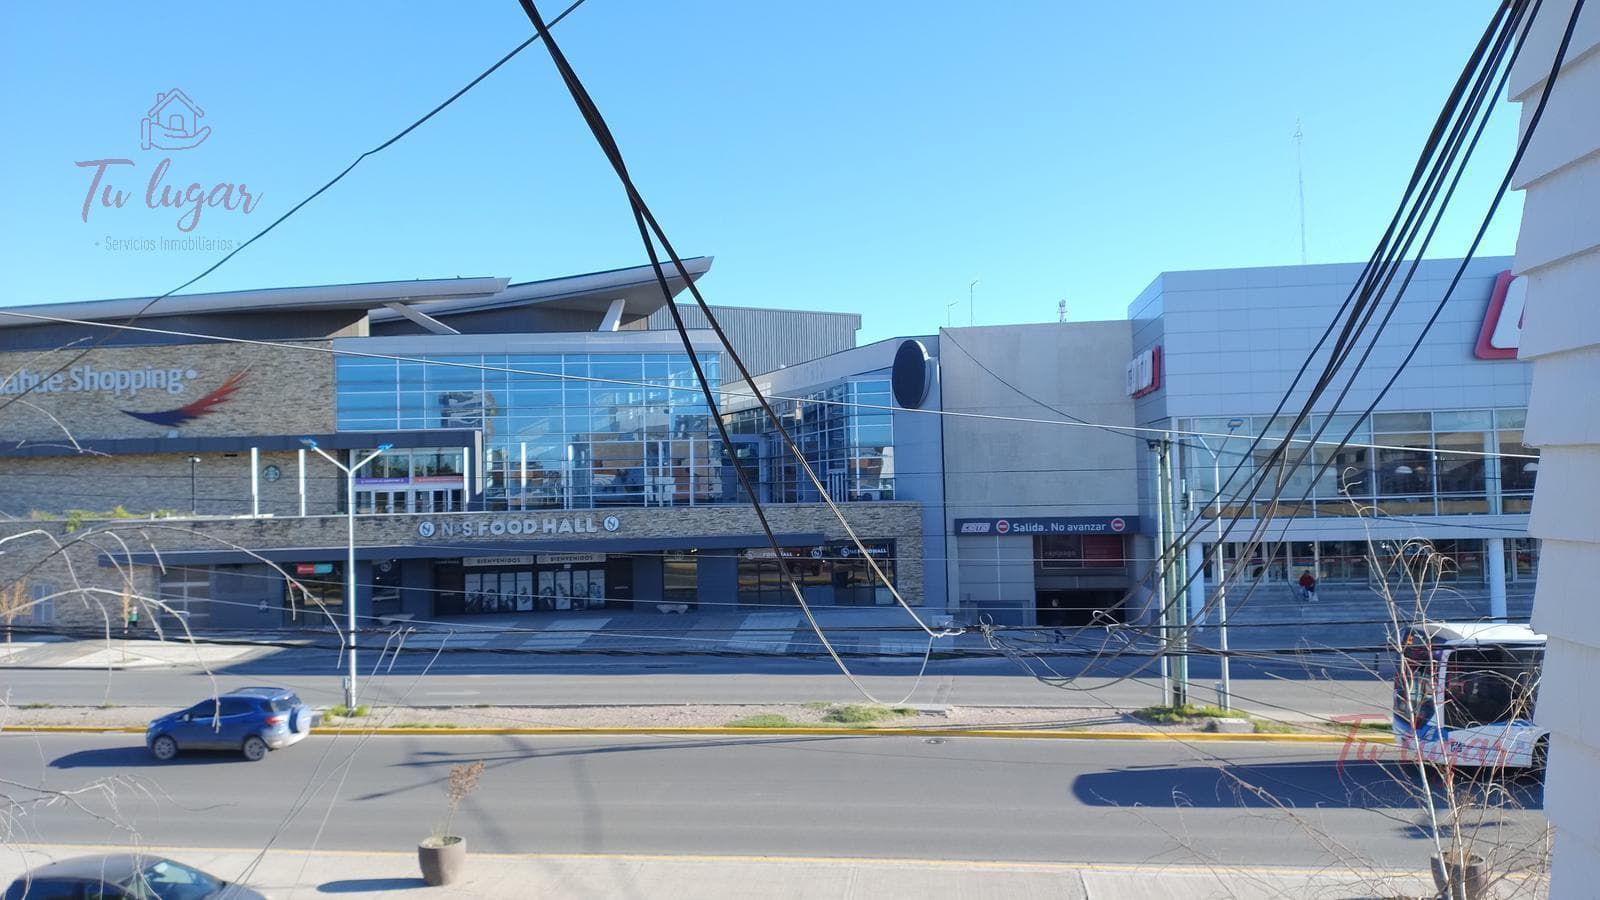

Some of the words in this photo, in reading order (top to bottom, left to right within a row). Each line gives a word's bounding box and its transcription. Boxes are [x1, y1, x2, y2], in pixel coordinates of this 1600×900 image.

[0, 368, 65, 395] ahue
[68, 365, 184, 395] Shopping
[478, 519, 538, 536] FOOD
[543, 517, 597, 534] HALL
[1013, 522, 1048, 532] Salida.
[1051, 522, 1065, 531] No
[1067, 523, 1107, 532] avanzar
